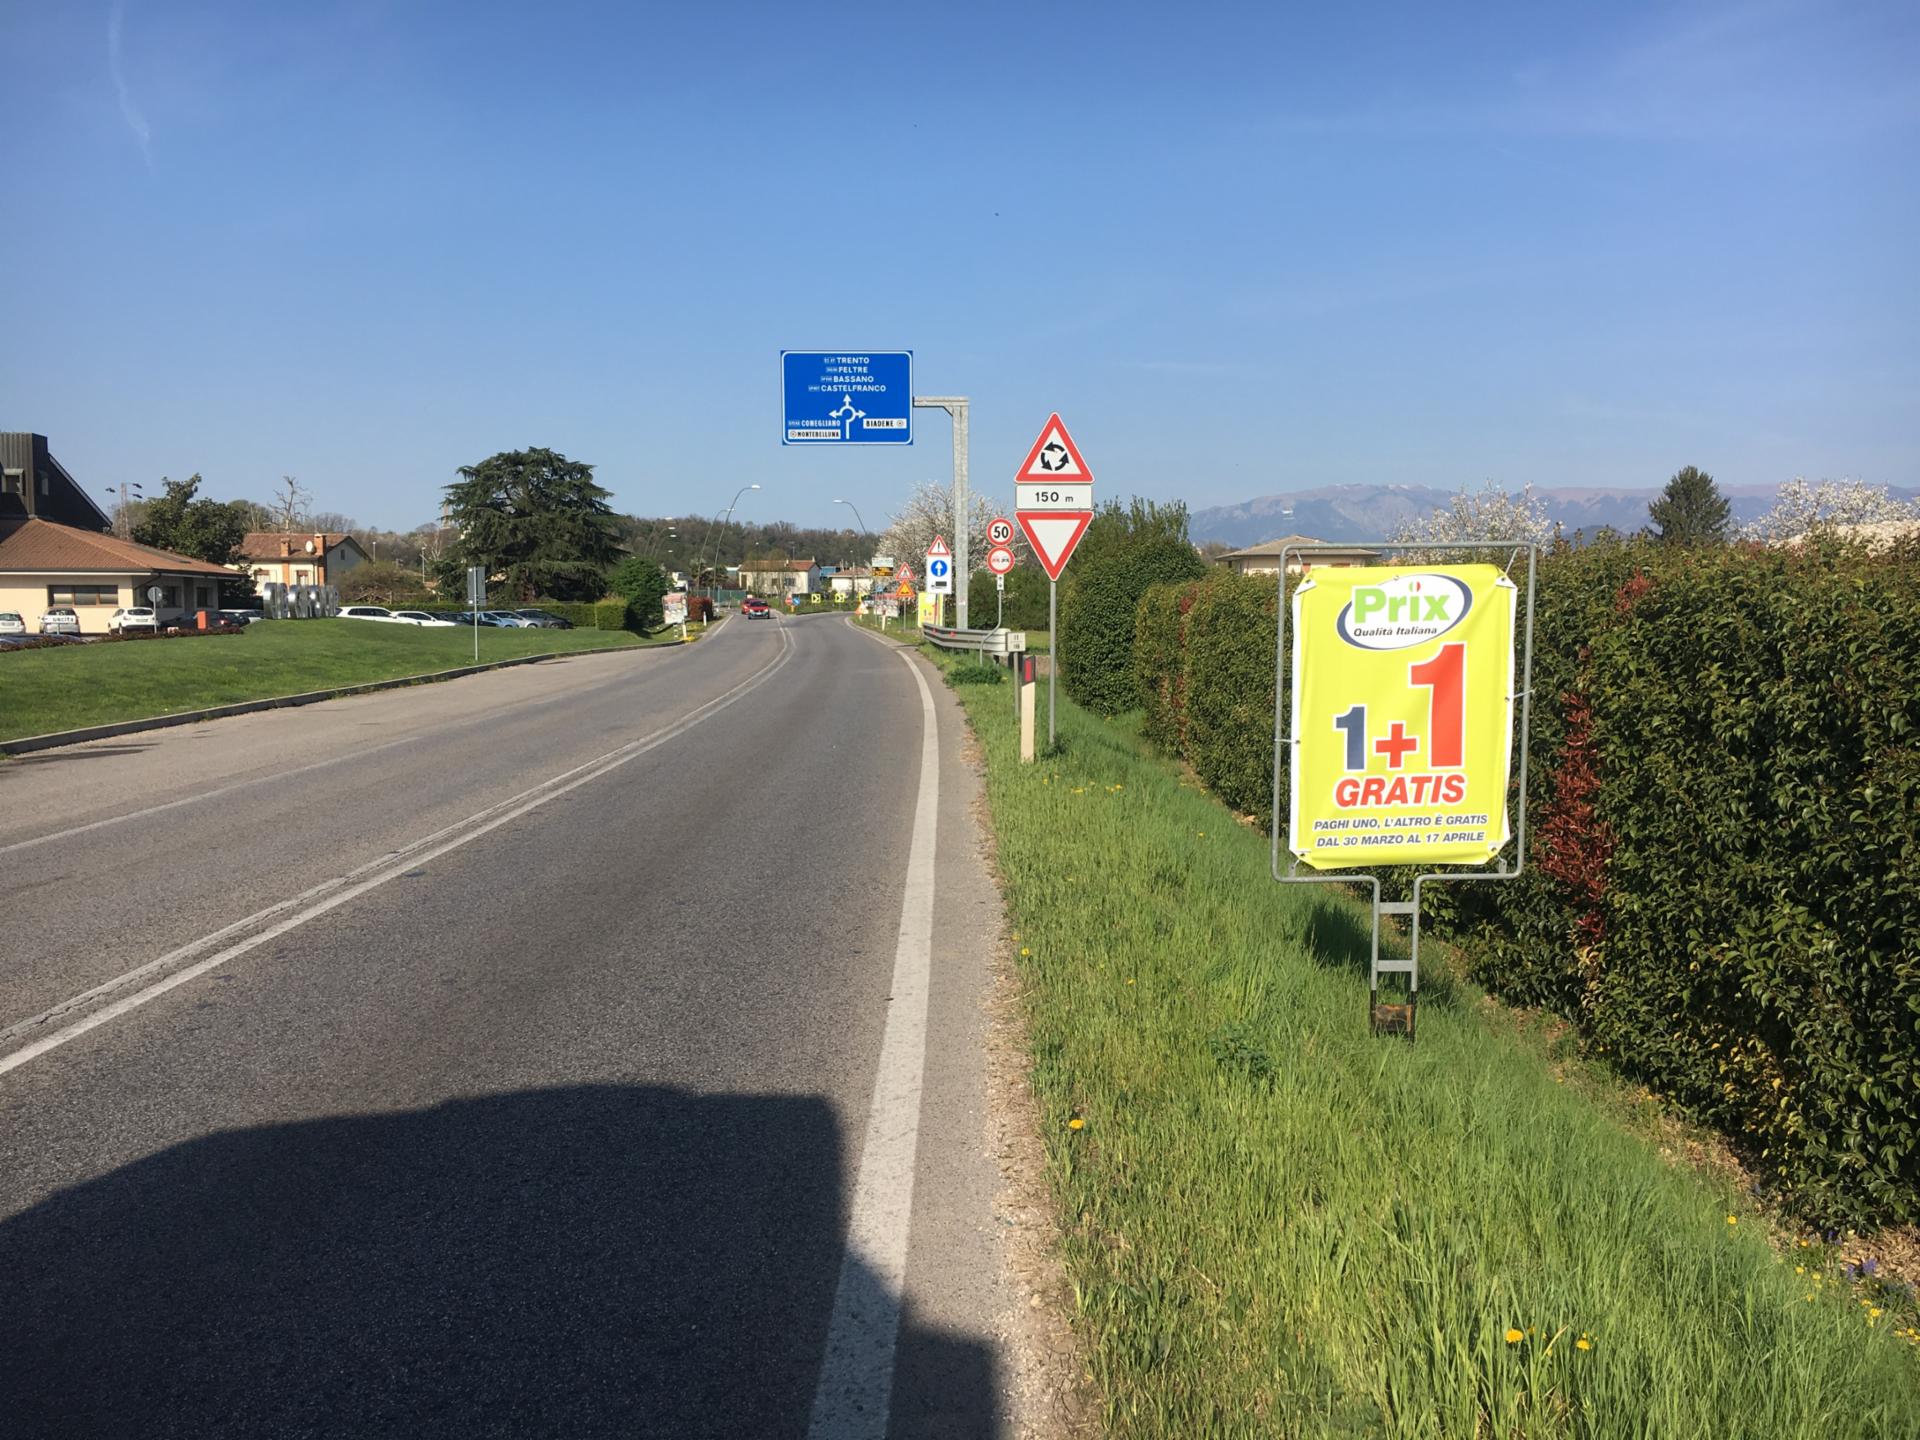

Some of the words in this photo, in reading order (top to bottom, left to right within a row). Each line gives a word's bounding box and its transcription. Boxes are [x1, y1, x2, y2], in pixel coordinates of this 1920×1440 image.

[801, 419, 841, 427] CONEGLIANO
[798, 430, 840, 438] MONTEBELLUNA
[1035, 491, 1059, 503] 150
[1065, 494, 1074, 503] m
[994, 526, 1009, 539] 50
[1354, 581, 1450, 624] Prix
[1396, 626, 1437, 635] Italiana
[1336, 774, 1465, 808] GRATIS
[1314, 820, 1349, 830] PAGHI
[1352, 818, 1381, 829] UNO,
[1384, 817, 1431, 827] L'ALTRO
[1435, 814, 1443, 826] È
[1446, 814, 1488, 825] GRATIS
[1316, 838, 1339, 847] DAL
[1343, 837, 1358, 846] 30
[1361, 834, 1404, 845] MARZO
[1407, 834, 1421, 843] AL
[1426, 834, 1440, 843] 17
[1443, 832, 1485, 842] APRILE
